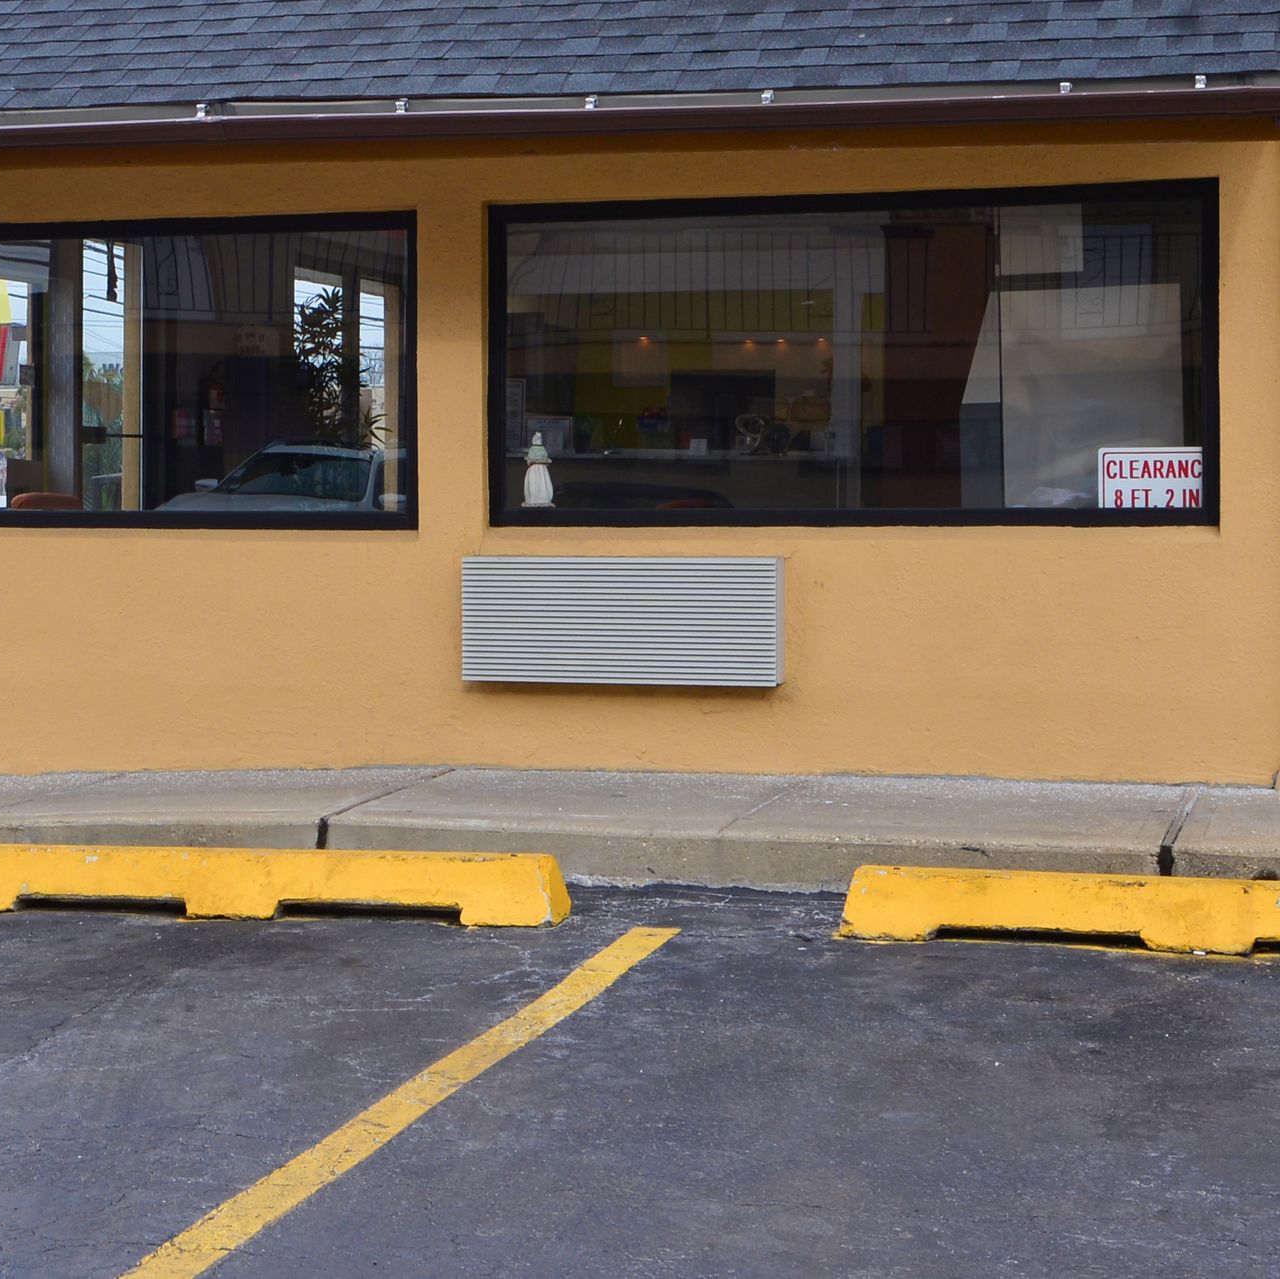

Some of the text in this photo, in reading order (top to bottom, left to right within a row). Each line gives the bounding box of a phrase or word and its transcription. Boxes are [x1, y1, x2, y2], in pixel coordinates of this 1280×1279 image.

[1105, 459, 1202, 479] CLEARANC
[1114, 488, 1123, 509] 8
[1165, 488, 1175, 509] 2
